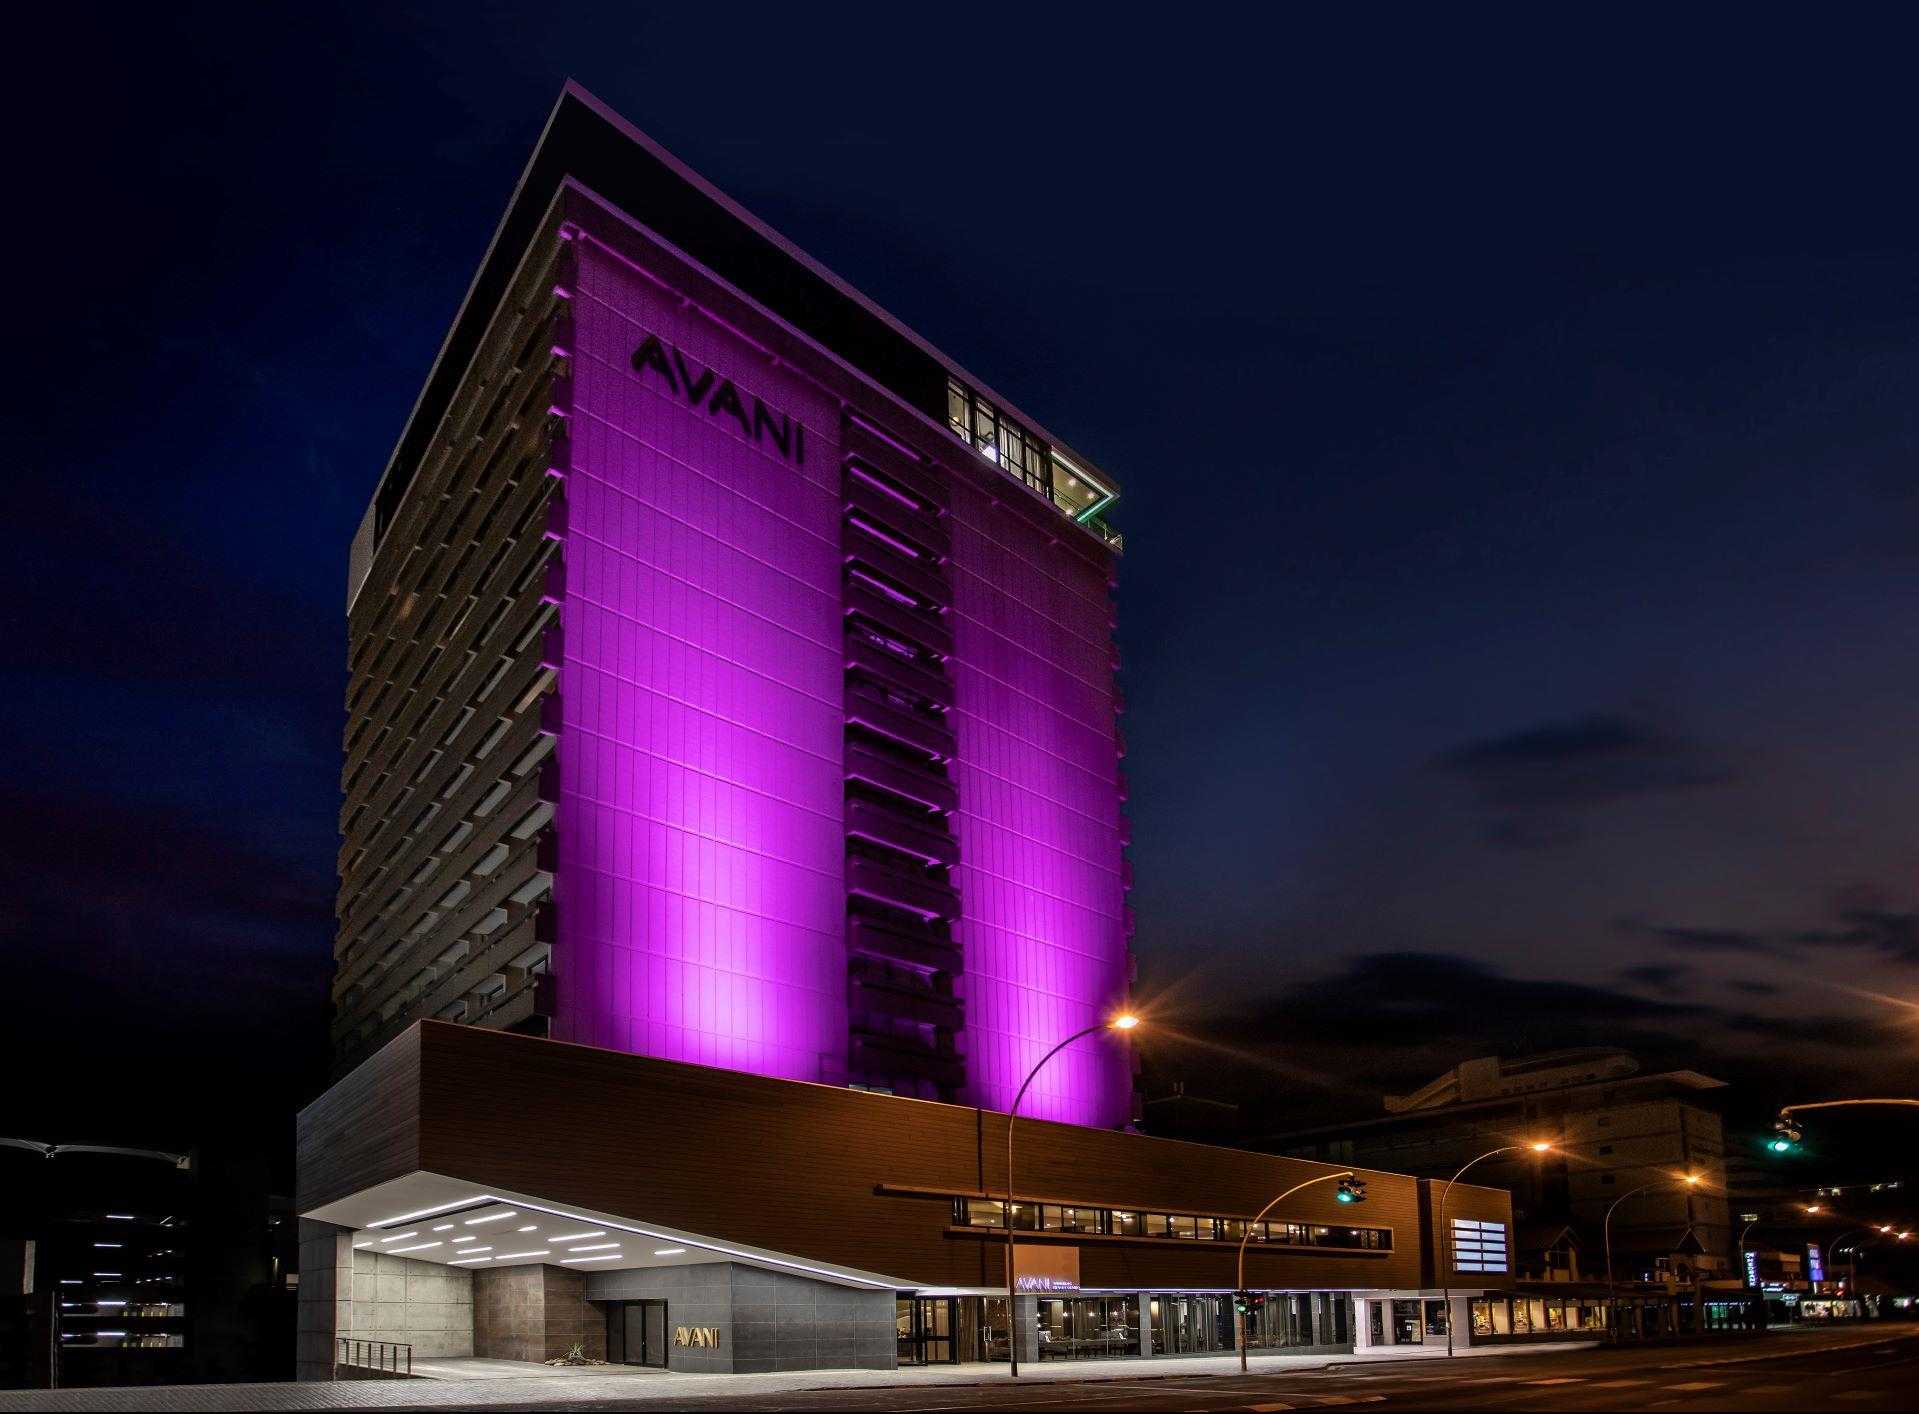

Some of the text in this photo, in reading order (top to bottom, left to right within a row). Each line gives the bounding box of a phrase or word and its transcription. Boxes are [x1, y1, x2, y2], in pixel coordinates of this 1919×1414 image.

[631, 334, 804, 465] AVANI
[1016, 1277, 1050, 1290] AVANI
[674, 1326, 719, 1348] AVANI
